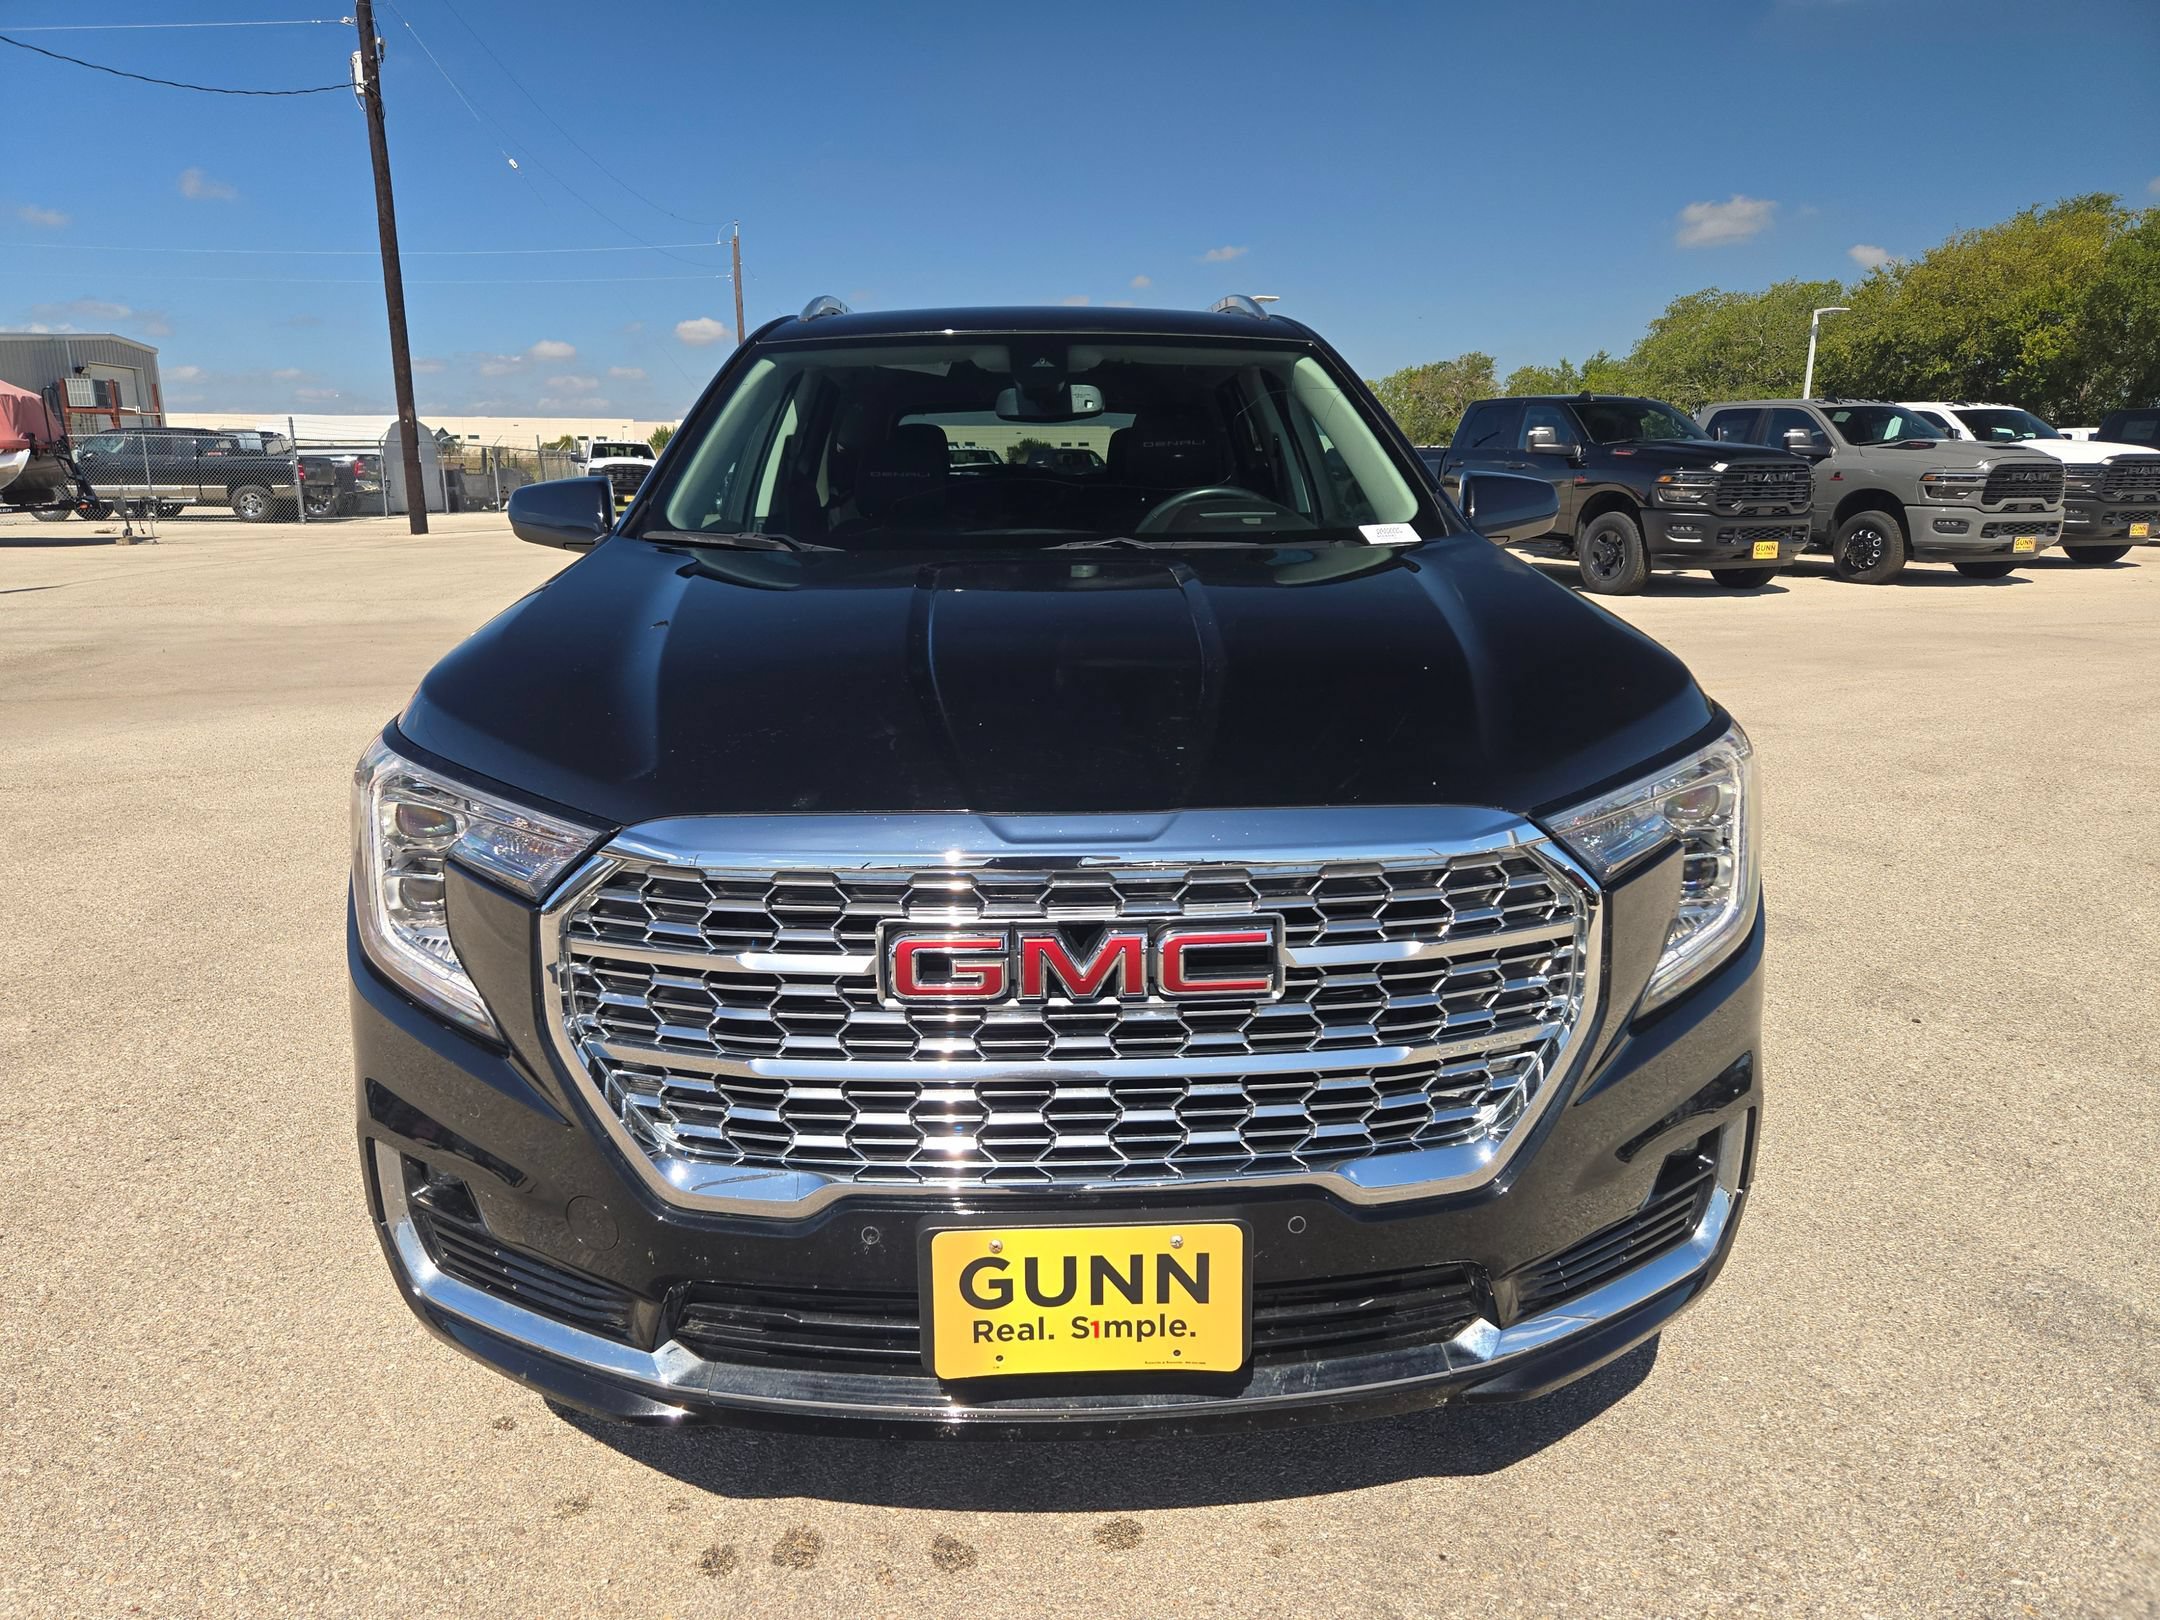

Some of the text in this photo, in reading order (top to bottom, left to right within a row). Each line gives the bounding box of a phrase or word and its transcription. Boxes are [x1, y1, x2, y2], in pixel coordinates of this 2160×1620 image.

[1747, 472, 1793, 482] RAM
[2011, 472, 2050, 481] RAM
[891, 928, 1274, 1002] GMC
[1437, 1032, 1528, 1056] DENALI
[958, 1252, 1211, 1311] GUNN
[972, 1316, 1056, 1344] Real.
